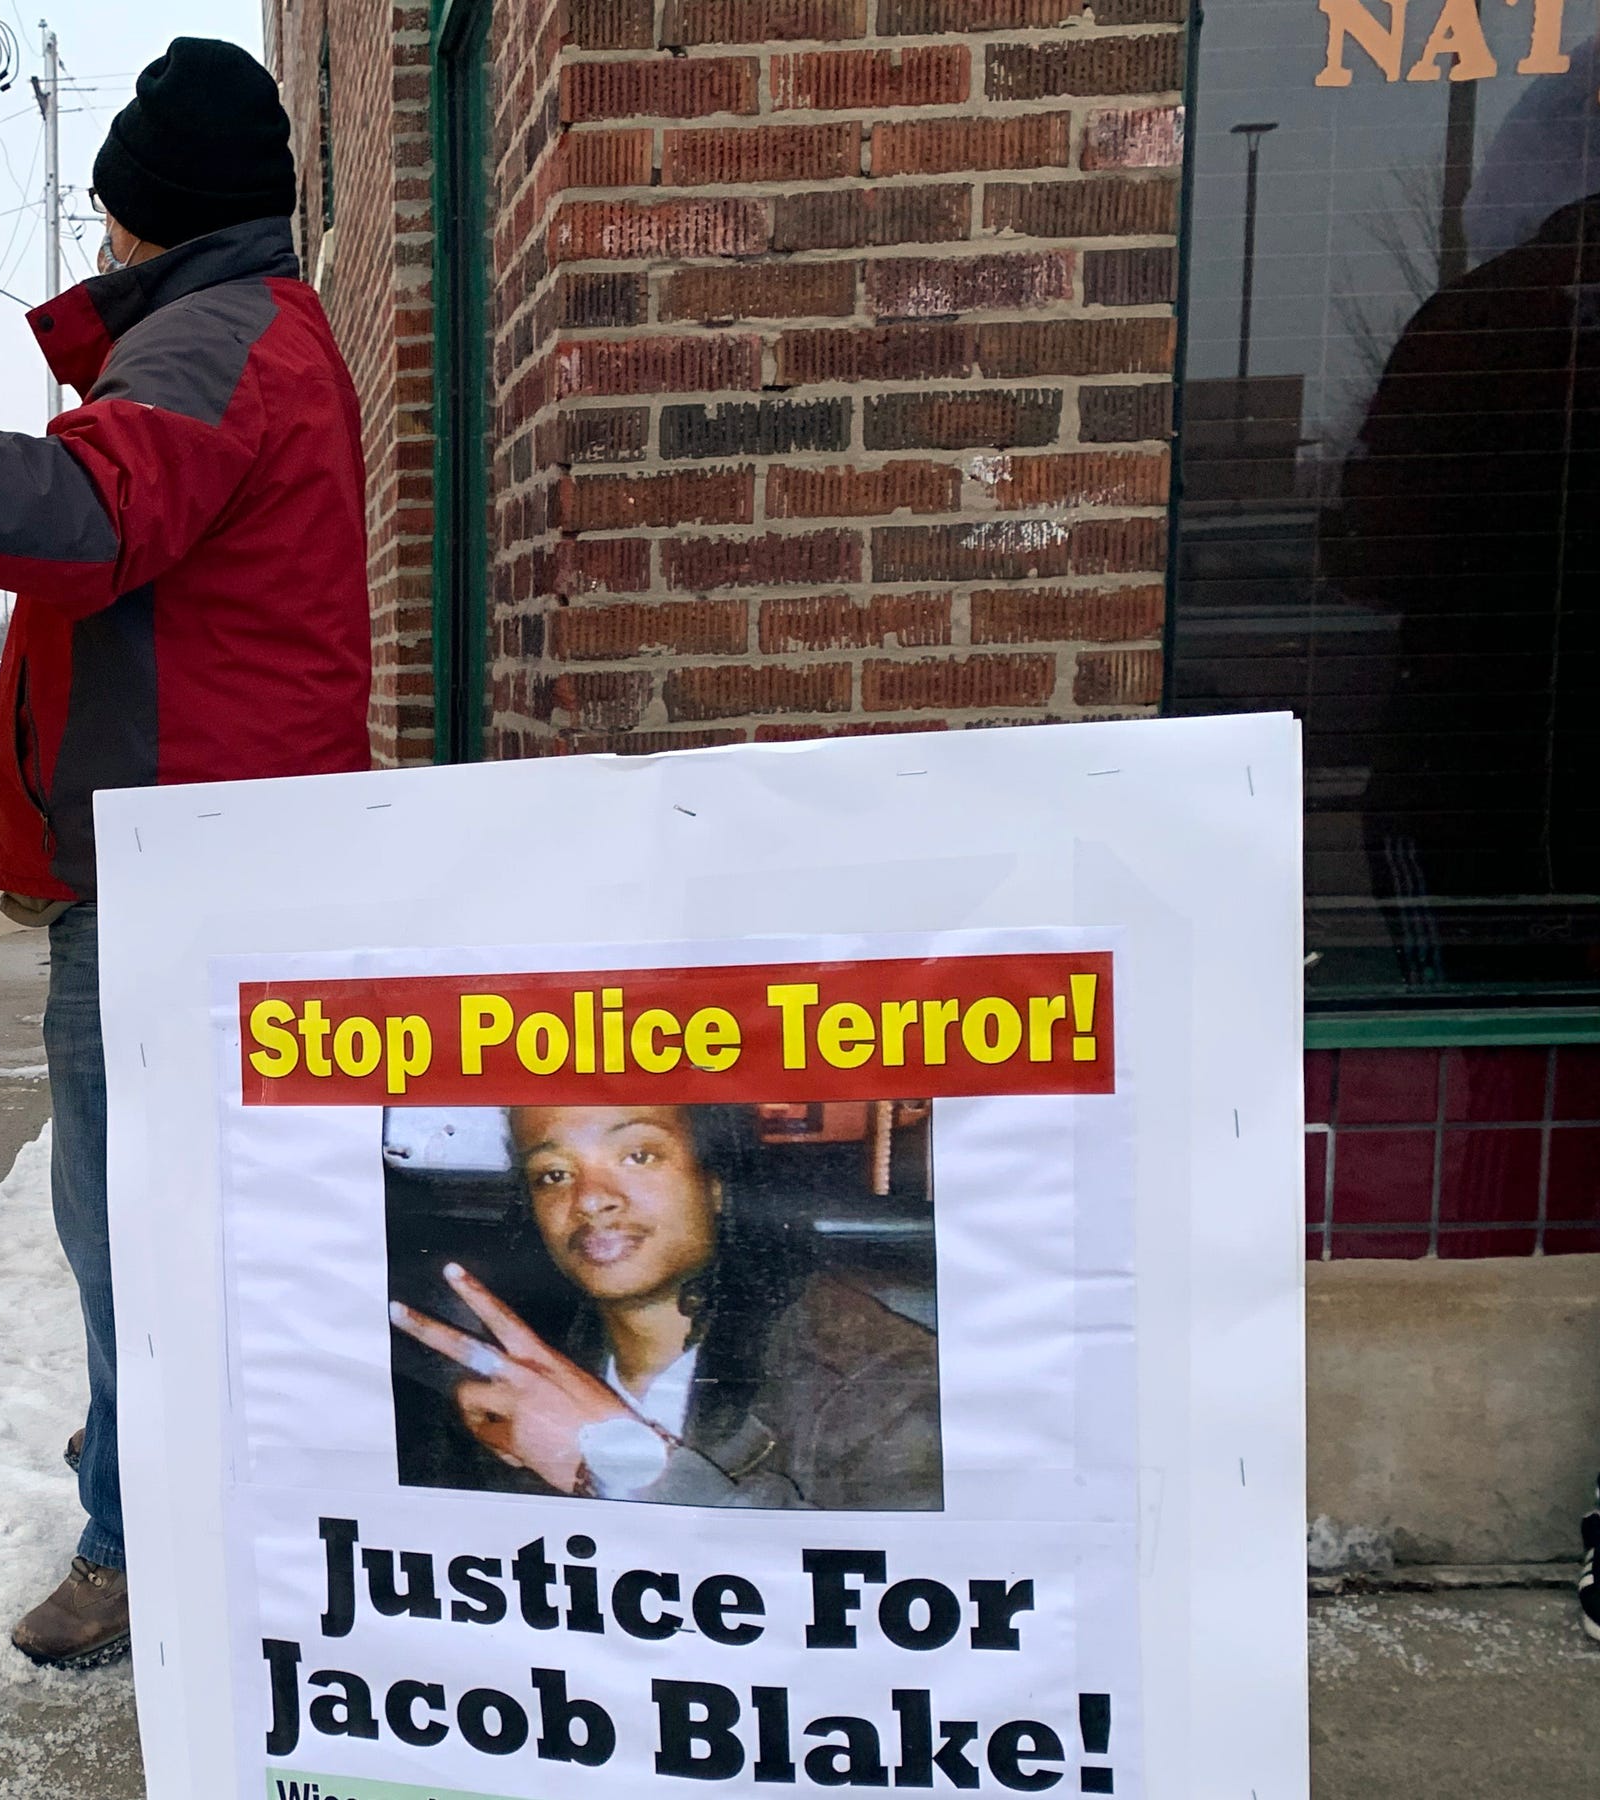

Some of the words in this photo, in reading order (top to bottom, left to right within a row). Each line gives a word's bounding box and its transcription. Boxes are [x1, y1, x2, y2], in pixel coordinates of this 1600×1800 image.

[248, 999, 433, 1095] Stop
[459, 987, 742, 1076] Police
[767, 973, 1098, 1070] Terror!
[318, 1516, 767, 1646] Justice
[801, 1547, 1035, 1652] For
[261, 1637, 617, 1768] Jacob
[650, 1677, 1115, 1795] Blake!
